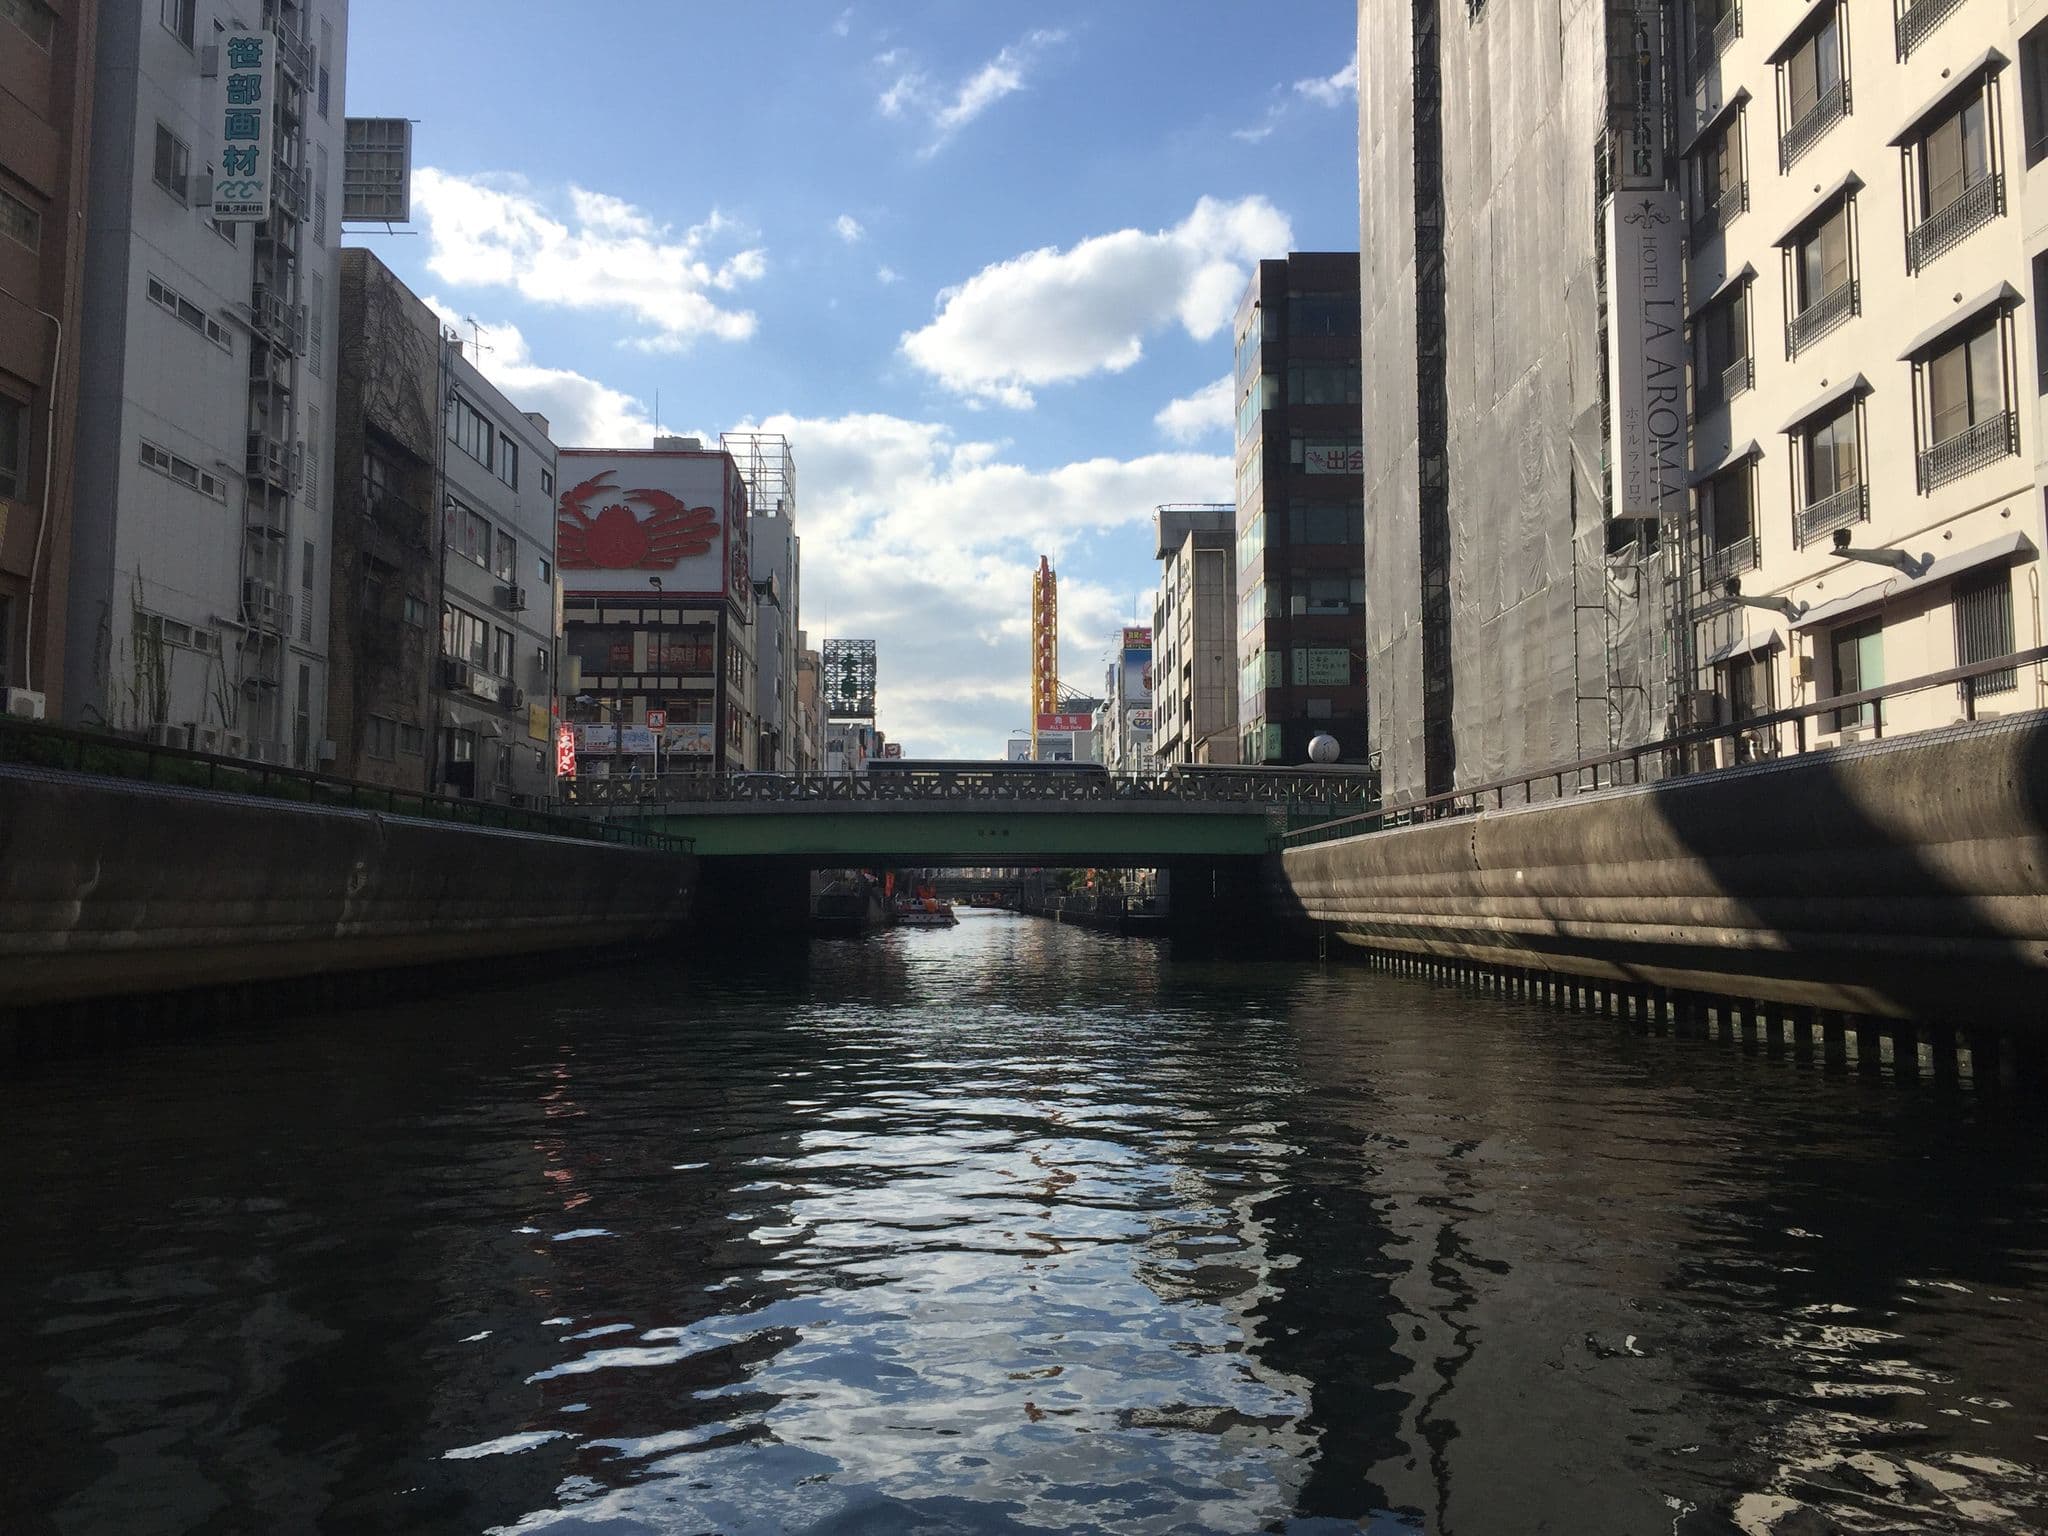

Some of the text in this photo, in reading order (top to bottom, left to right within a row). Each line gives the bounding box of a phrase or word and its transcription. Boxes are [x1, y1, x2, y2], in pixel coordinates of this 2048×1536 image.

[223, 37, 263, 177] 笹部画材
[1643, 236, 1681, 505] HOTEL LA AROMA
